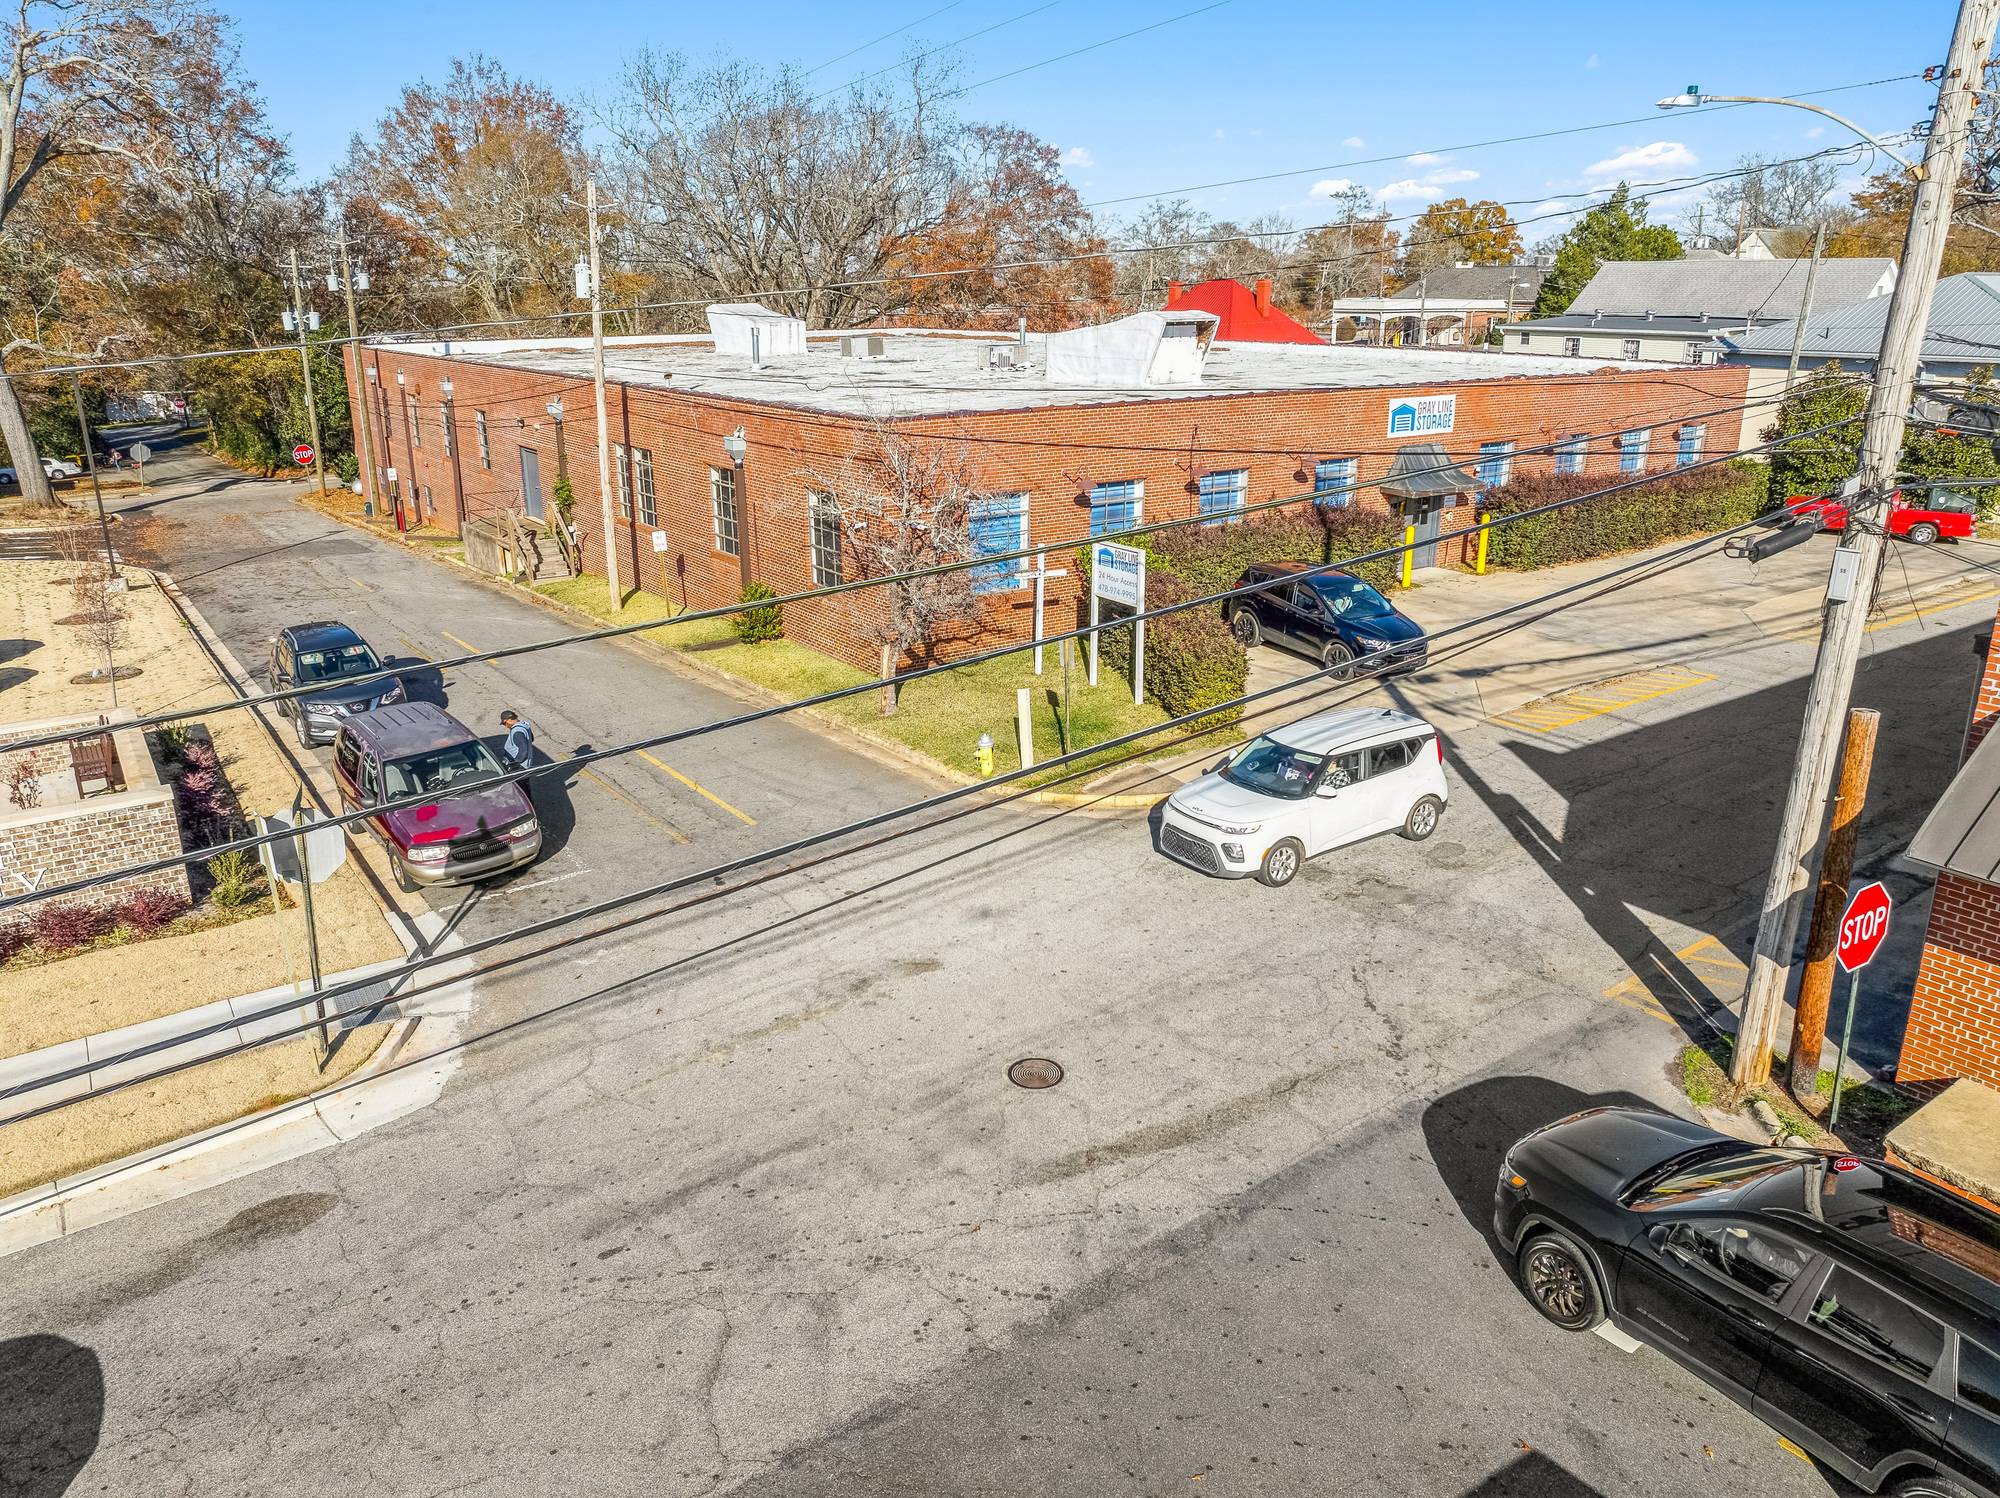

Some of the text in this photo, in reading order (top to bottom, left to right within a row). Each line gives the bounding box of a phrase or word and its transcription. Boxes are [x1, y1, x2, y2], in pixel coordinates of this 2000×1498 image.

[1418, 400, 1453, 415] GRAY LINE
[1416, 413, 1452, 430] STORAGE
[294, 449, 314, 460] STOP
[1842, 906, 1886, 949] STOP
